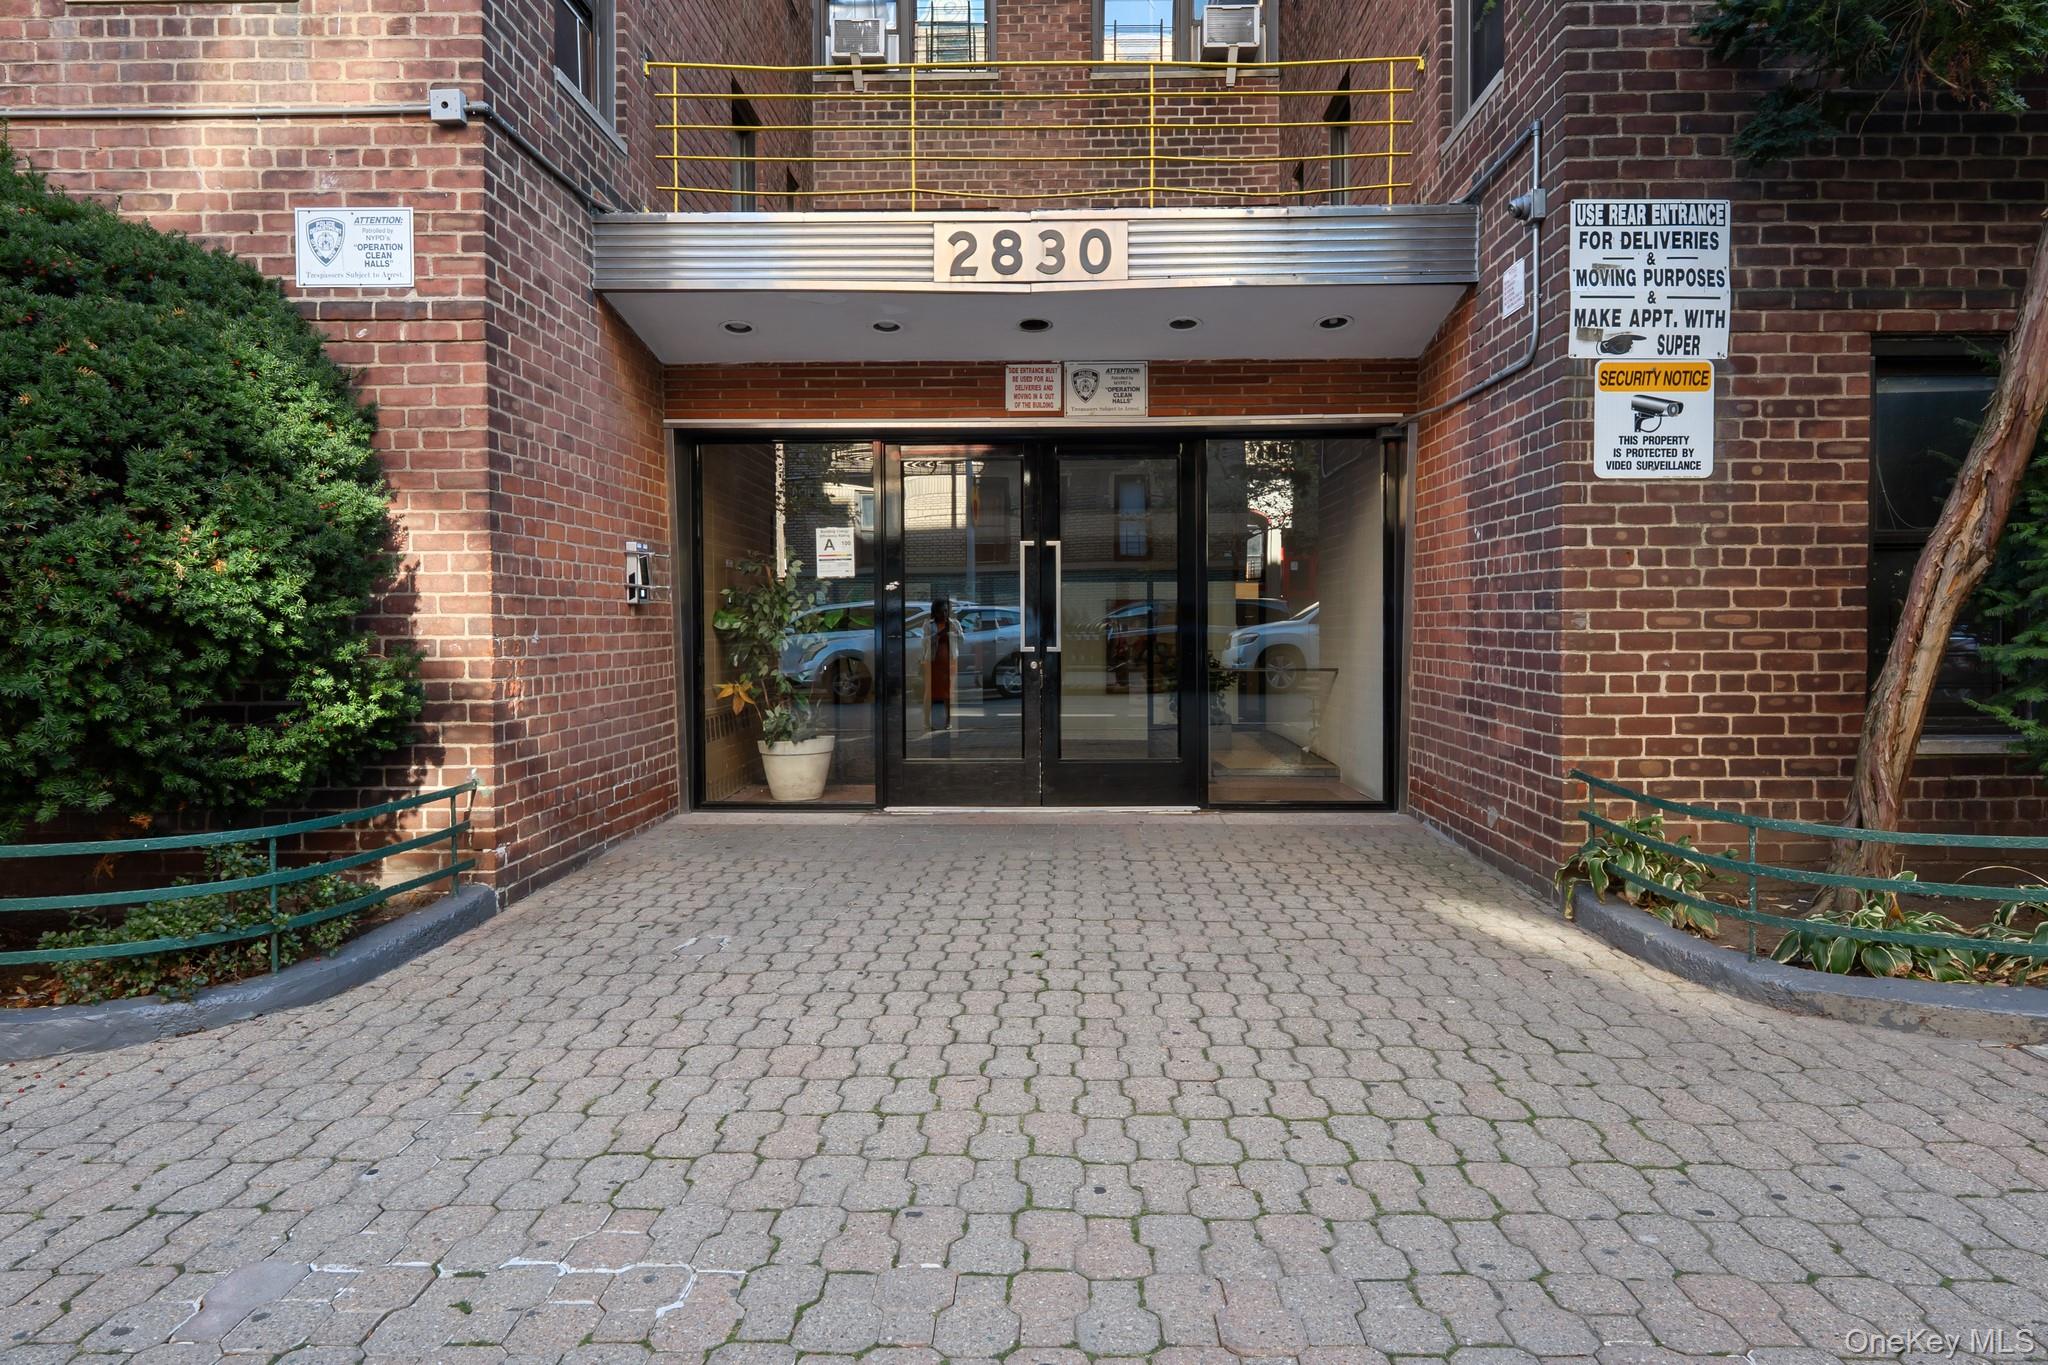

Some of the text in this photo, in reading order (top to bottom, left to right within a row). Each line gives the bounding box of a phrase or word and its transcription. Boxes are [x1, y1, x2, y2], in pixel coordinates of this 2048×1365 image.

[1577, 204, 1725, 225] USE REAR ENTRANCE
[1579, 231, 1719, 250] FOR DELIVERIES
[948, 228, 1112, 276] 2830
[1647, 252, 1656, 265] &
[1576, 268, 1725, 287] MOVING PURPOSES
[1647, 291, 1656, 304] &
[1575, 308, 1725, 328] MAKE APPT. WITH
[1657, 334, 1700, 355] SUPER
[1600, 370, 1710, 386] SECURITY NOTICE
[1619, 436, 1690, 445] THIS PROPERTY
[1613, 448, 1695, 457] IS PROTECTED BY
[1606, 461, 1701, 470] VIDEO SURVEILLANCE
[824, 538, 835, 551] A
